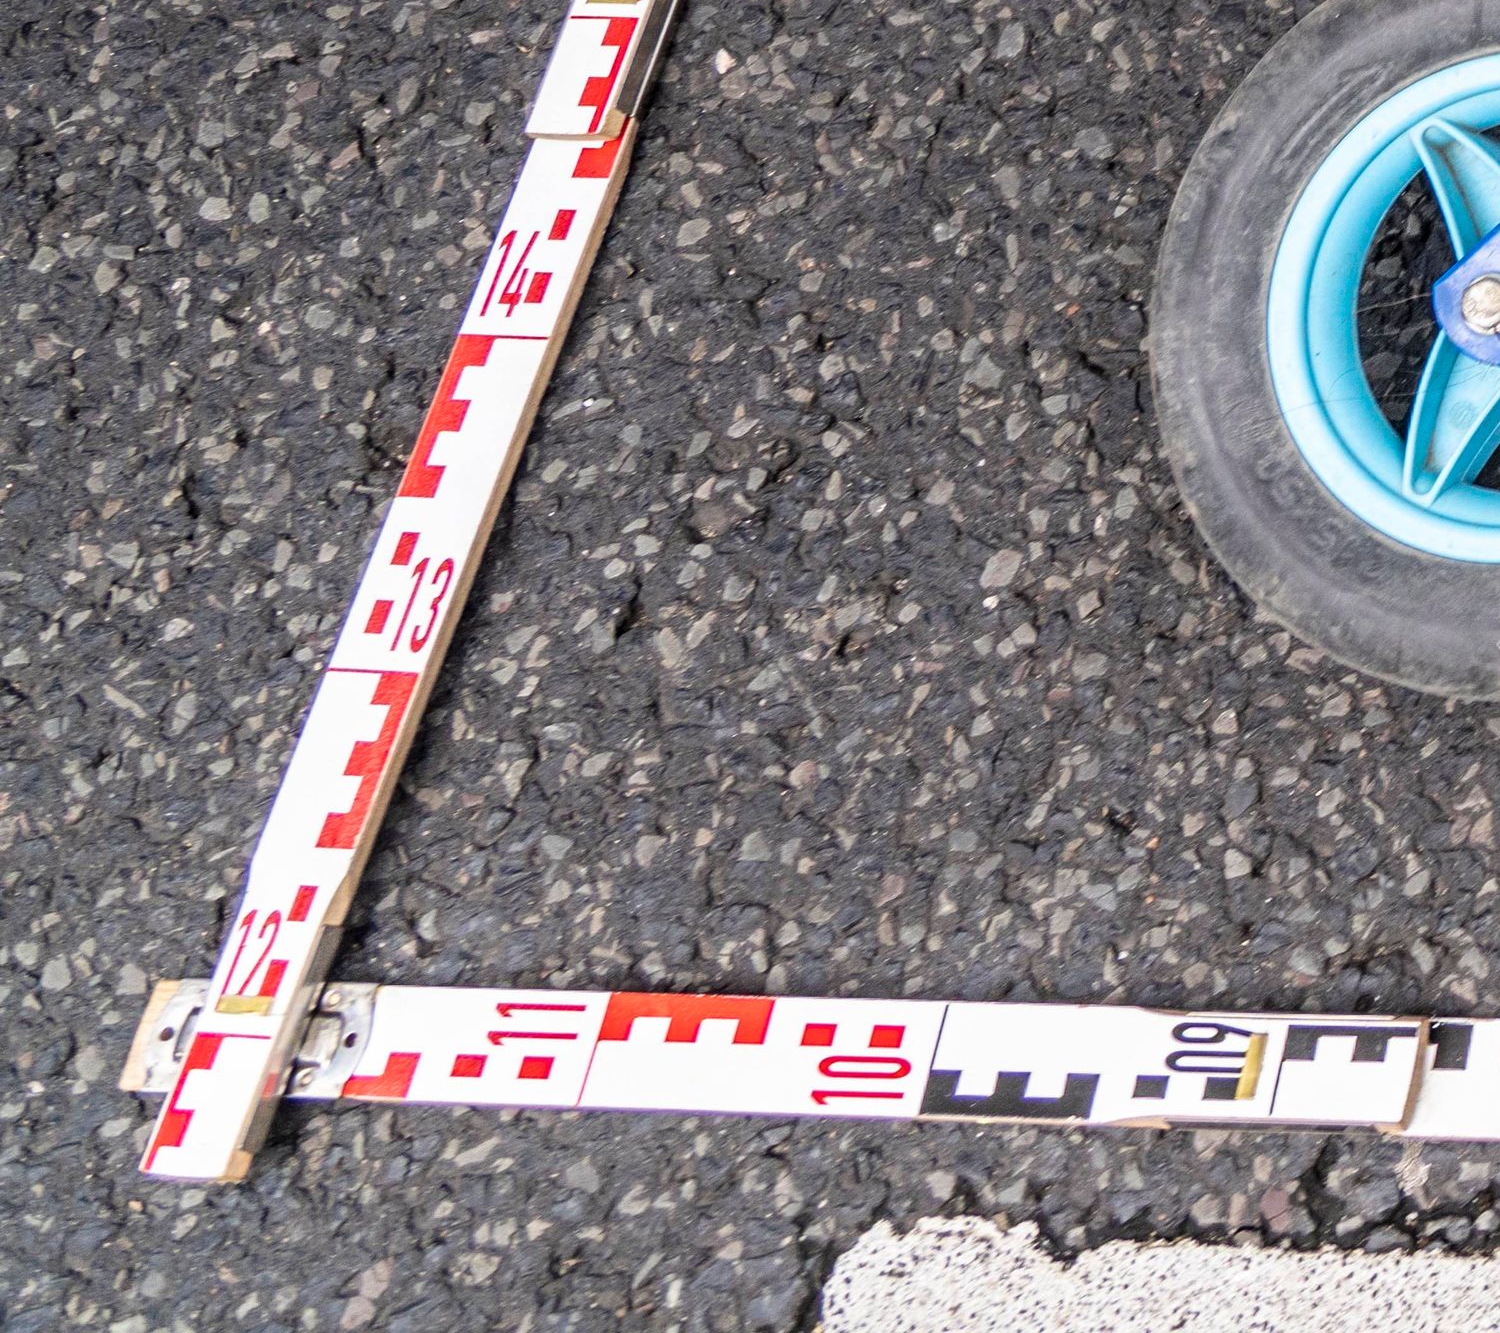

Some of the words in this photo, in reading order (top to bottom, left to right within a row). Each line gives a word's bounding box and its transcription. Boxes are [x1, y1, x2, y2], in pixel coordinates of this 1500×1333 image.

[480, 230, 541, 319] 14
[390, 556, 455, 653] 13
[214, 908, 283, 1001] 12
[487, 1002, 587, 1046] 11
[1165, 1022, 1255, 1073] 09
[810, 1055, 912, 1106] 10
